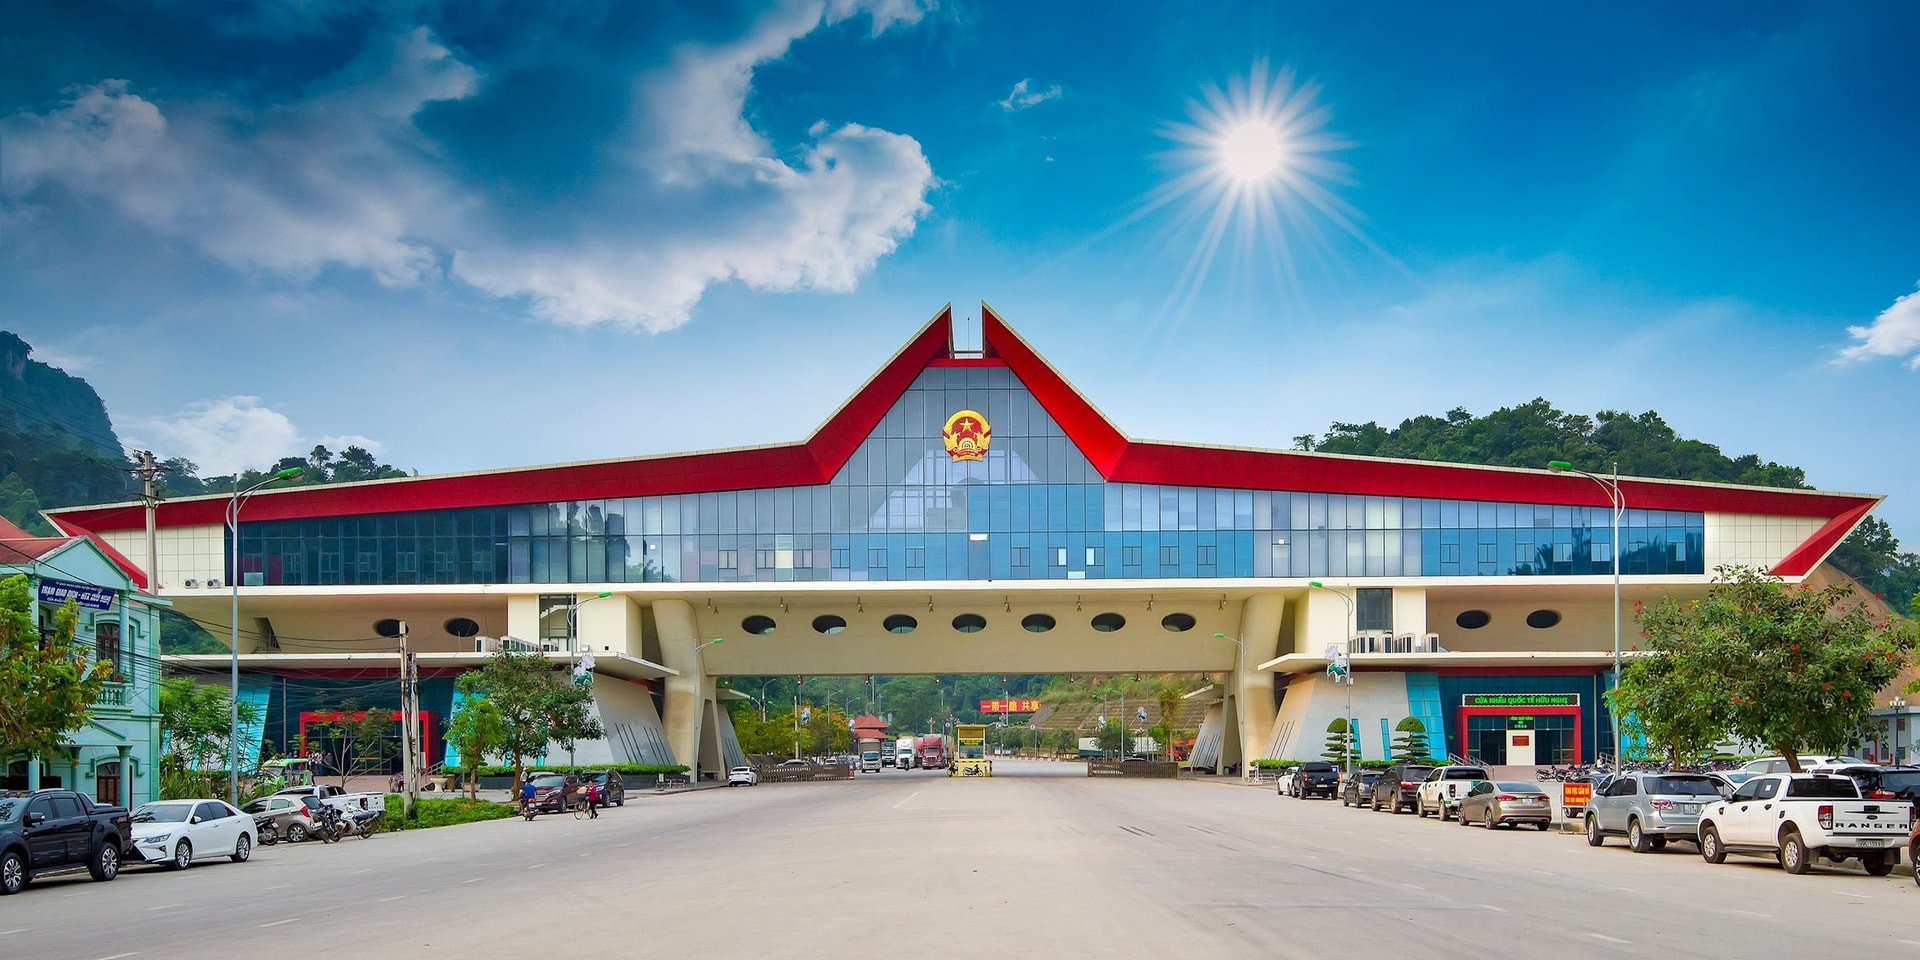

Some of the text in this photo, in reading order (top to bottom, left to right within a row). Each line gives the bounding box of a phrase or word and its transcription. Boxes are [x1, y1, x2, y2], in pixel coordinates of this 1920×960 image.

[1474, 696, 1488, 704] CỬA
[1507, 696, 1526, 705] QUỐC
[1527, 696, 1535, 704] TẾ
[1535, 696, 1550, 704] HỮU
[1551, 697, 1568, 705] NGHỊ
[982, 701, 1017, 711] 一带一路
